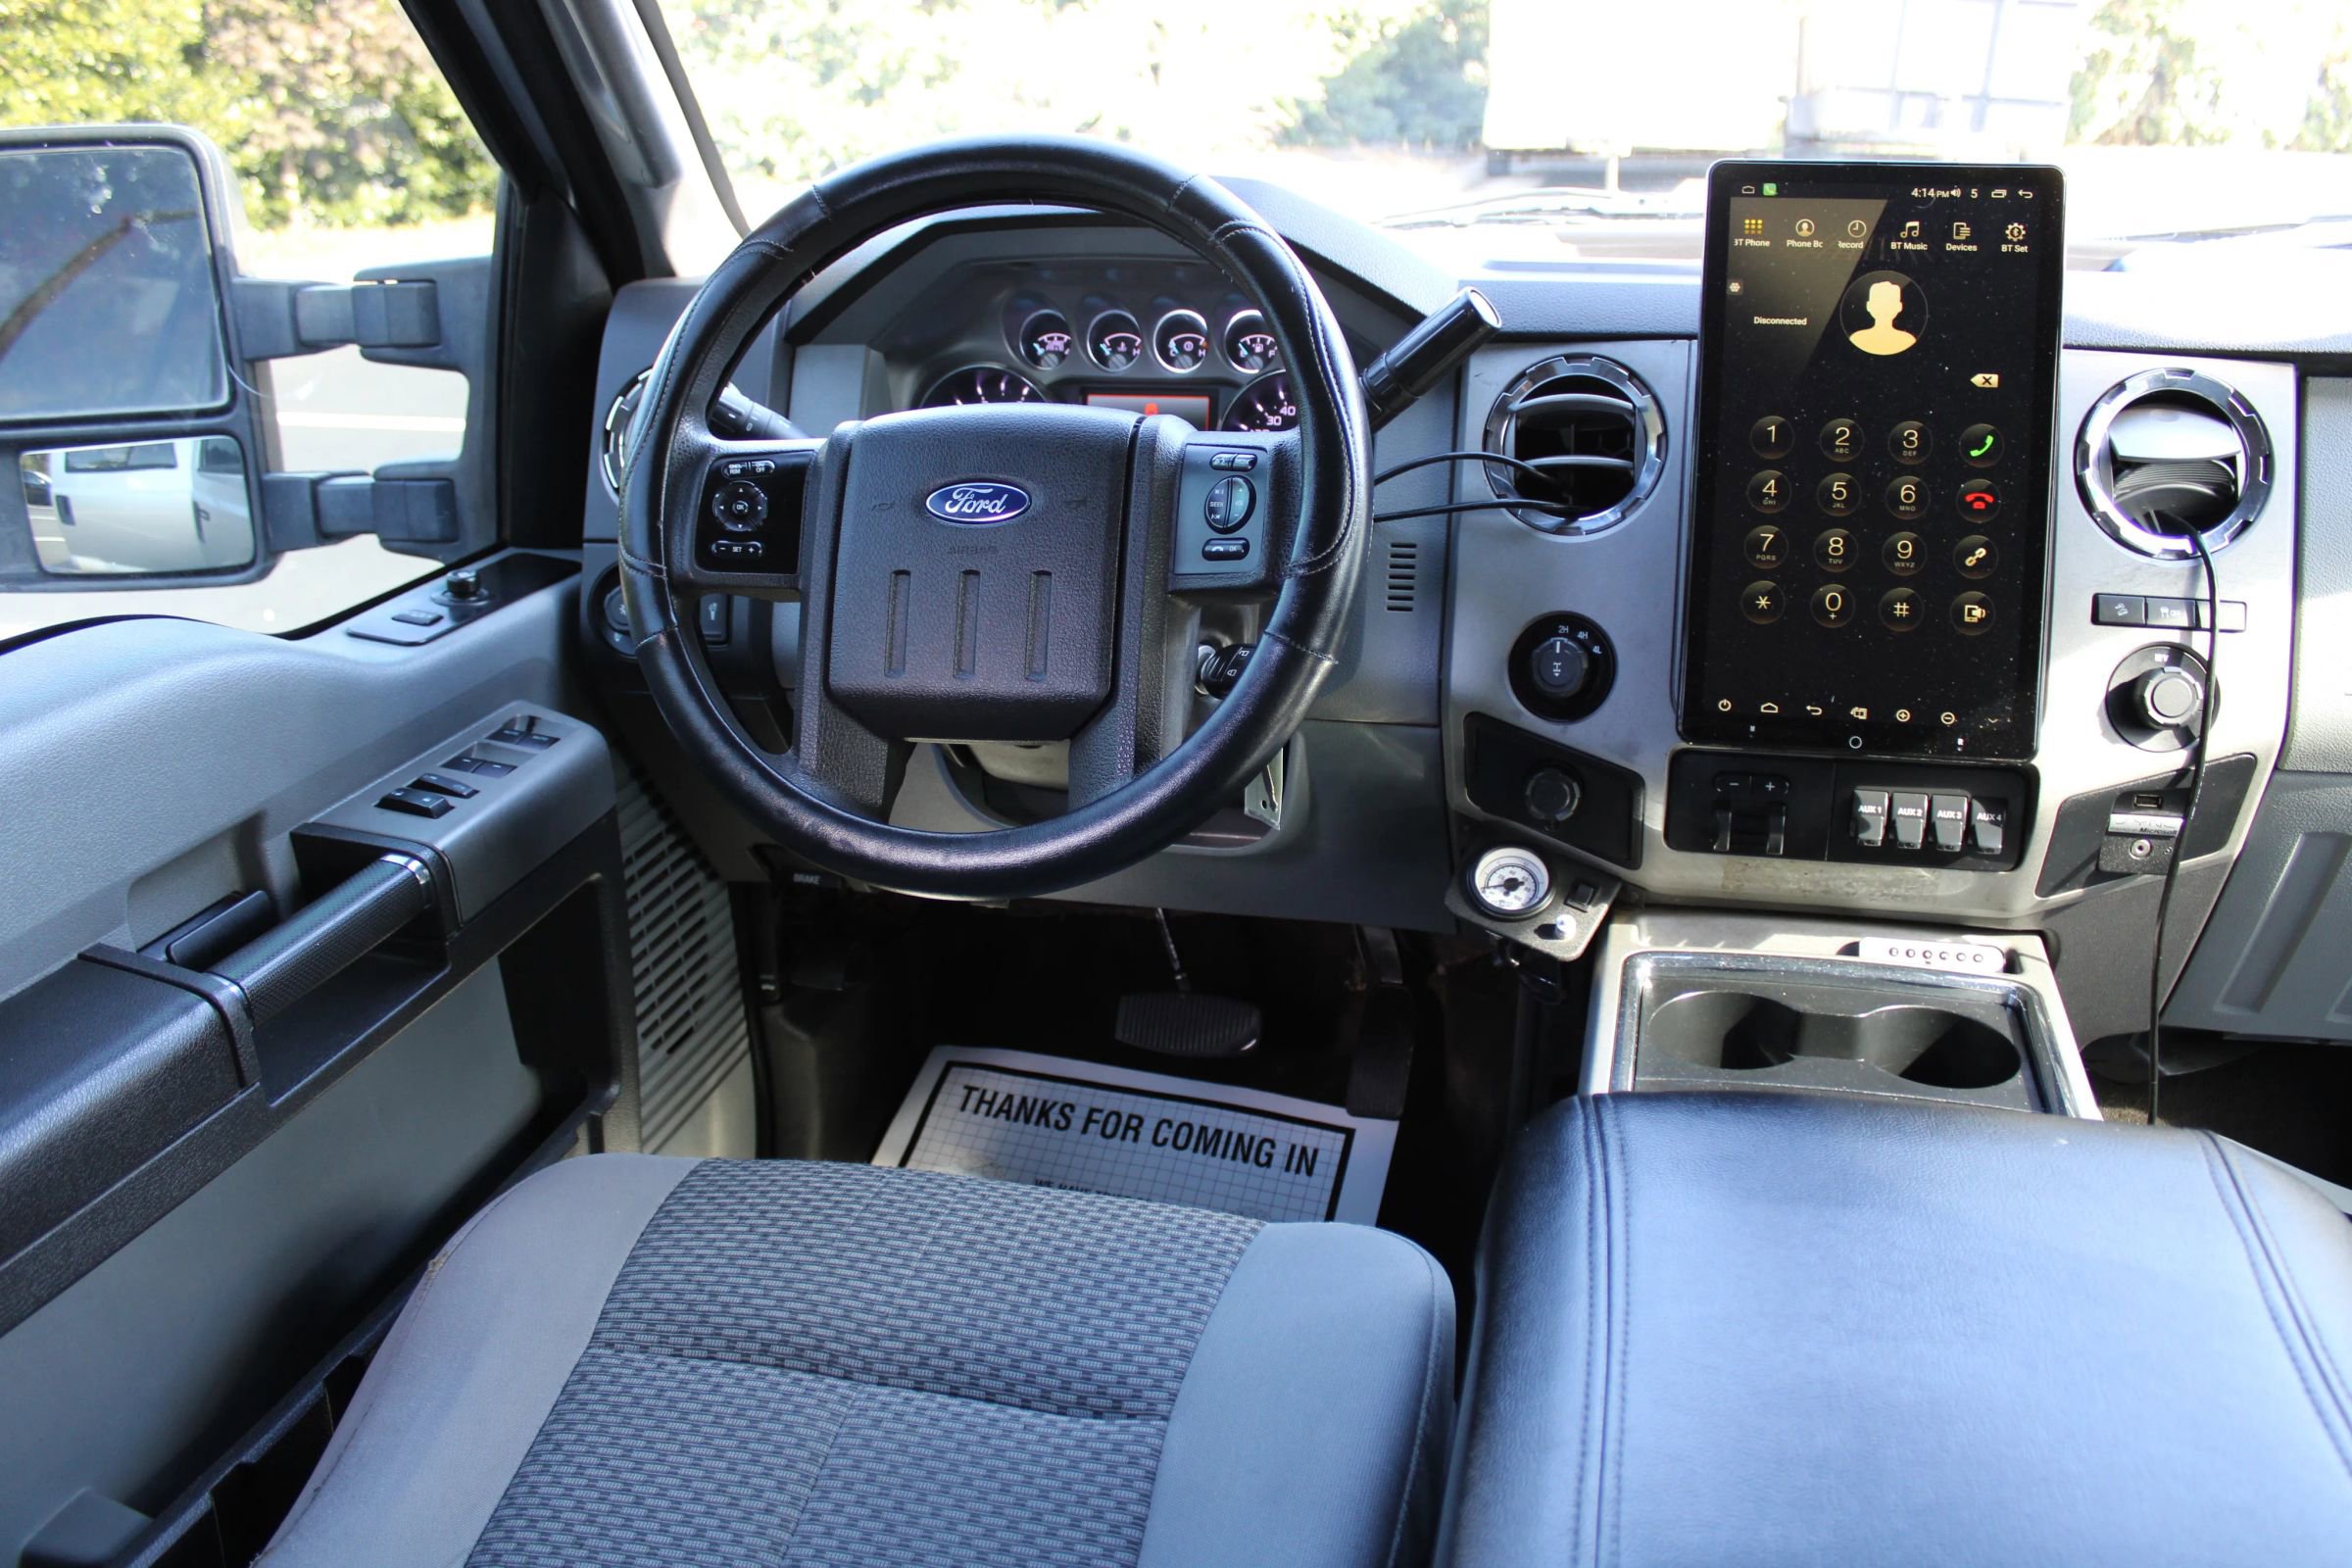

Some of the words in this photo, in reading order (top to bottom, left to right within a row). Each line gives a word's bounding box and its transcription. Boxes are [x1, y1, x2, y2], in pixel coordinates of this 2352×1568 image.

[1911, 188, 1936, 198] 4:14
[1970, 189, 1978, 199] 5
[1744, 238, 1771, 247] Phone
[1787, 239, 1812, 248] Phone
[1890, 241, 1902, 250] BT
[1903, 242, 1928, 251] Music
[1945, 243, 1978, 252] Devices
[2014, 244, 2029, 253] Set
[1753, 316, 1808, 325] Disconnected
[1279, 405, 1297, 416] 40
[1266, 415, 1283, 426] 30
[1766, 424, 1776, 443] 1
[1835, 426, 1850, 446] 2
[1902, 429, 1918, 449] 3
[1762, 478, 1777, 498] 4
[1832, 481, 1847, 501] 5
[1900, 484, 1916, 504] 6
[945, 487, 1008, 514] Ford
[1759, 533, 1775, 552] 7
[1828, 536, 1844, 557] 8
[1896, 540, 1913, 560] 9
[1825, 592, 1842, 612] 0
[1858, 805, 1877, 813] AUX
[1897, 808, 1916, 816] AUX
[1937, 809, 1956, 819] AUX
[1977, 812, 1995, 821] AUX
[959, 1084, 1076, 1131] THANKS
[1081, 1107, 1145, 1143] FOR
[1152, 1118, 1276, 1168] COMING
[1284, 1143, 1319, 1177] IN
